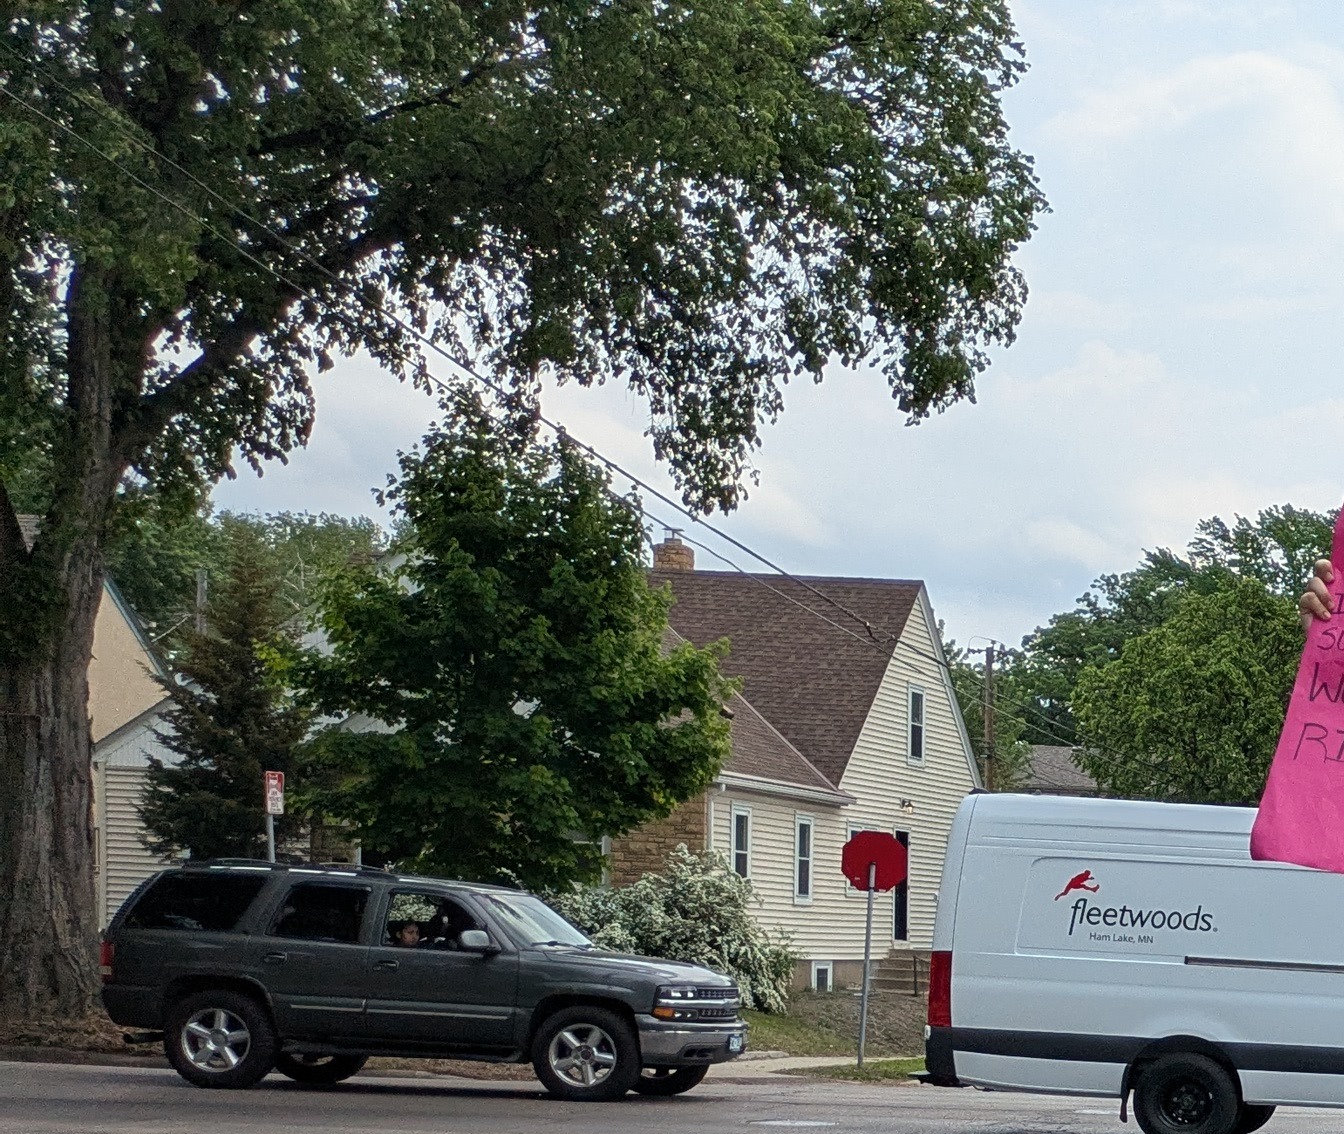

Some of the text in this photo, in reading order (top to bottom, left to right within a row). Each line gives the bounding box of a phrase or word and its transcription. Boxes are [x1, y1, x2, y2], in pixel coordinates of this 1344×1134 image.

[1089, 932, 1154, 944] Ham Lake, MN
